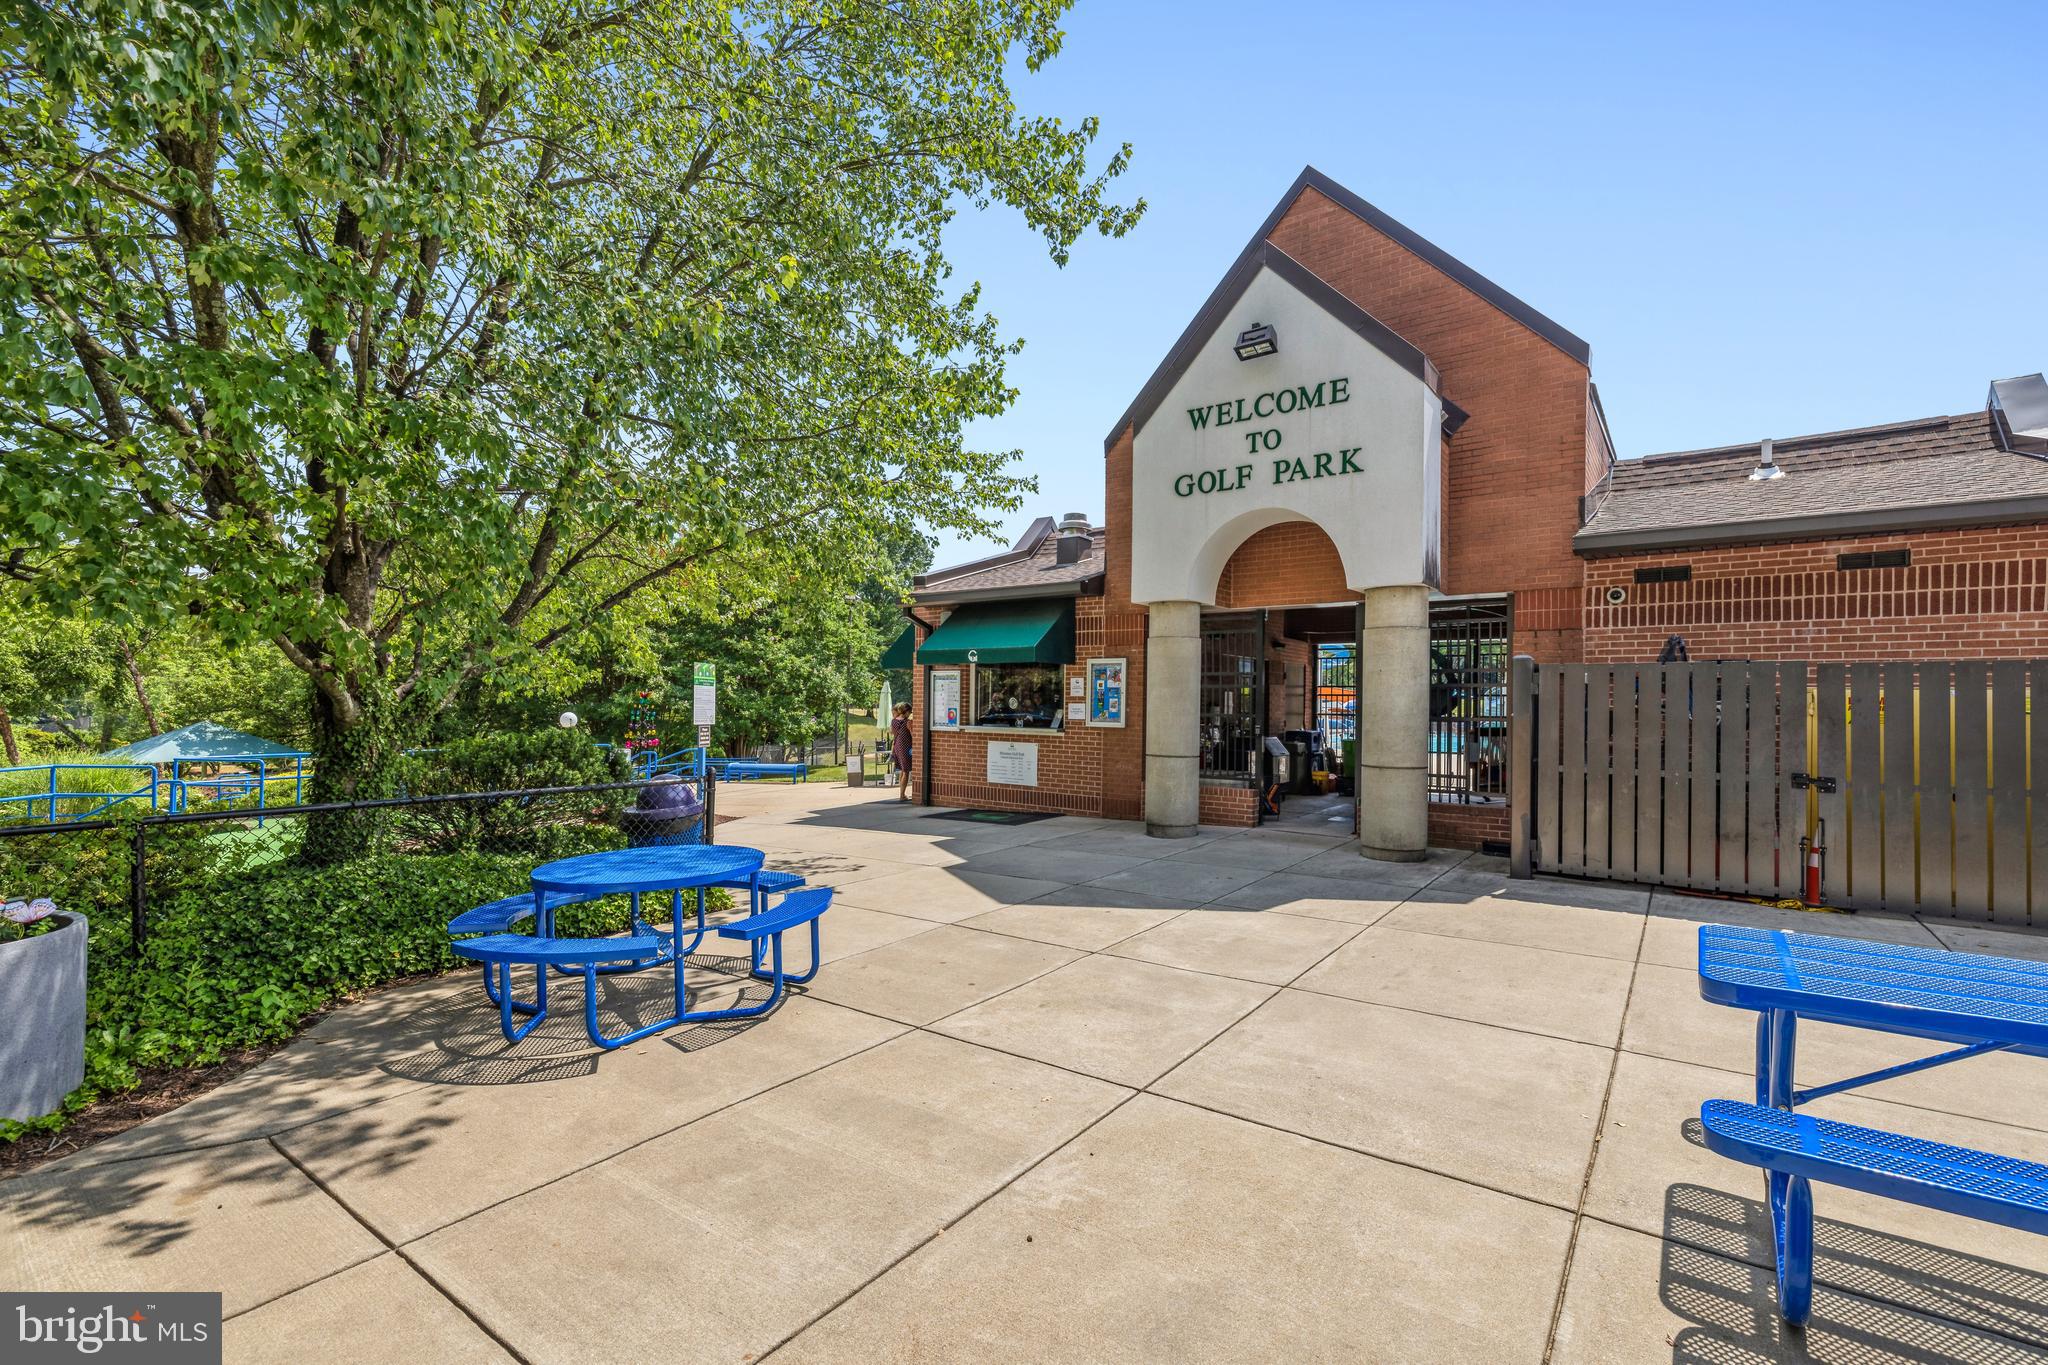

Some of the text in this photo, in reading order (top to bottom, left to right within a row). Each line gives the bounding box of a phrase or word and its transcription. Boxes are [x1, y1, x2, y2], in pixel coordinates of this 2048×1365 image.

[1187, 377, 1351, 431] WELCOME
[1246, 428, 1283, 454] TO
[1174, 447, 1365, 497] GOLF PARK
